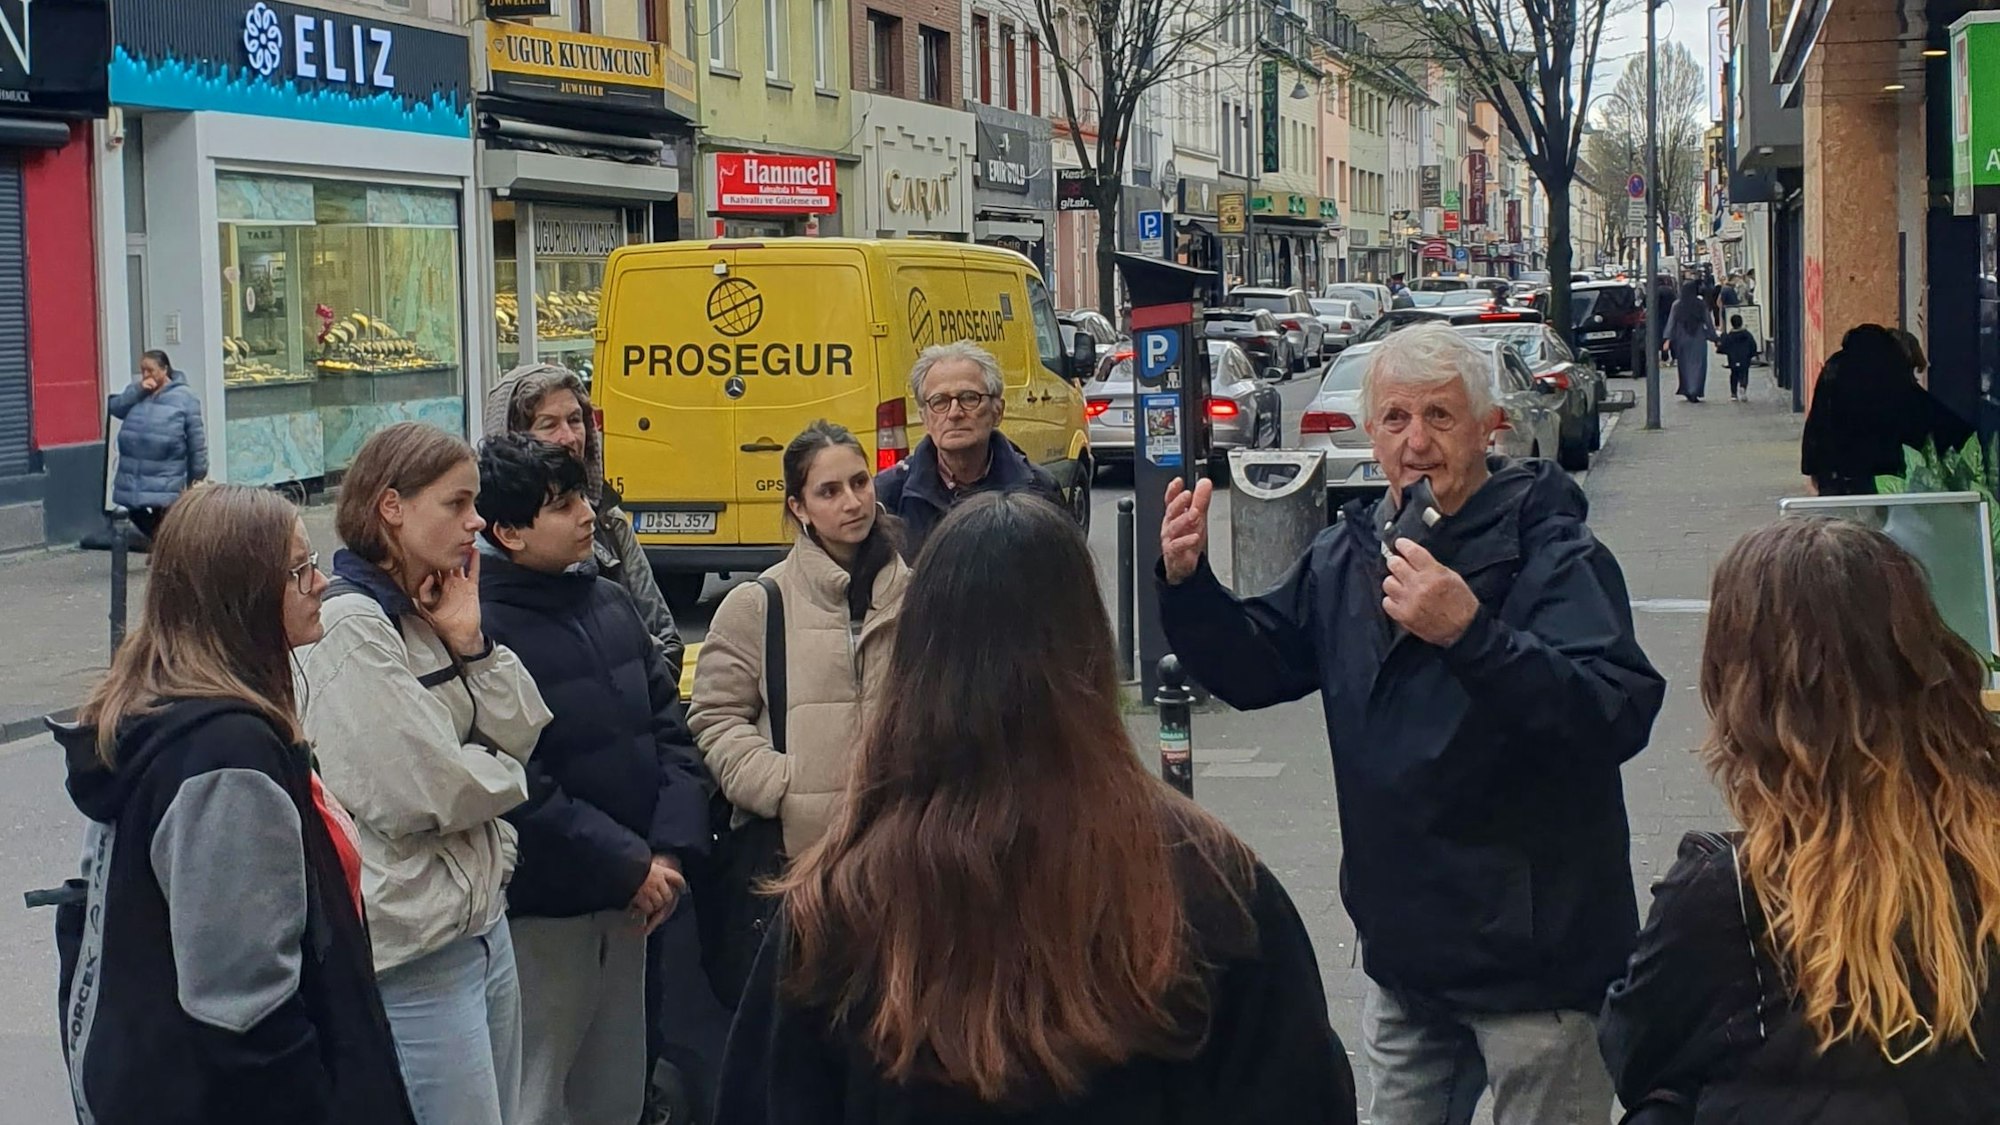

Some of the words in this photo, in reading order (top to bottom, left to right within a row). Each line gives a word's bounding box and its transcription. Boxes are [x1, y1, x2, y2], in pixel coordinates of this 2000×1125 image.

[294, 14, 395, 88] ELIZ
[558, 42, 652, 76] KUYUMCUSU
[560, 82, 604, 97] JUWELIER
[1006, 162, 1025, 186] GOLD
[1985, 148, 2000, 172] A
[887, 166, 959, 221] CARAT
[1144, 214, 1158, 237] P
[939, 309, 1005, 344] PROSEGUR
[623, 343, 853, 377] PROSEGUR
[1146, 334, 1169, 369] P
[756, 479, 785, 491] GPS
[646, 512, 655, 527] D
[664, 512, 681, 528] SL
[684, 513, 710, 528] 357
